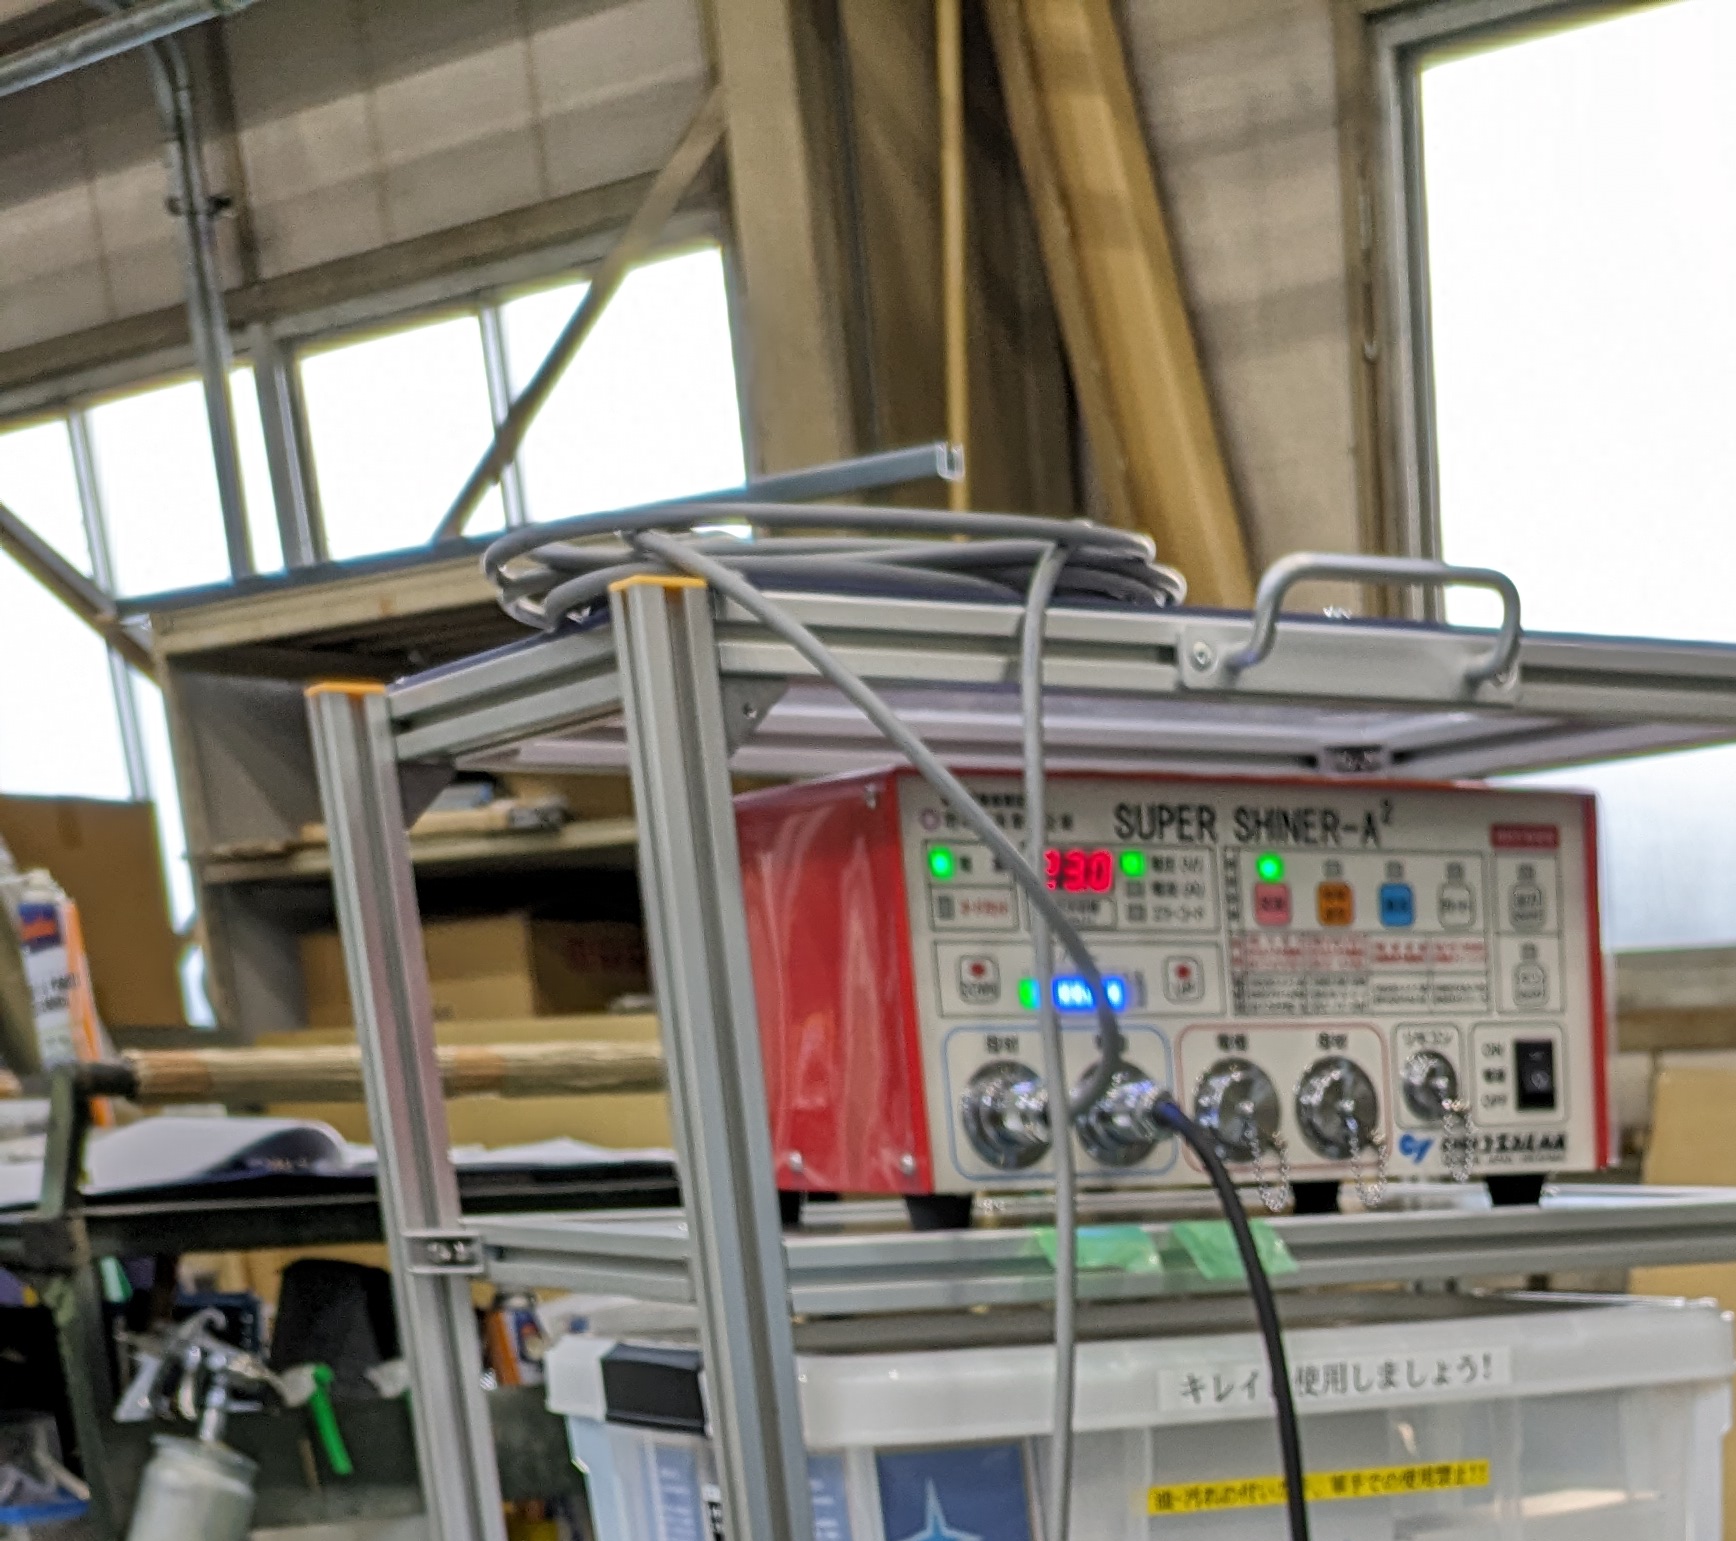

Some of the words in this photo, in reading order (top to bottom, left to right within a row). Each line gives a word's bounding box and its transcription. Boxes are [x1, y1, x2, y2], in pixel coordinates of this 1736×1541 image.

[1113, 802, 1217, 842] SUPER
[1180, 1352, 1493, 1404] キレイ使用しましょう!
